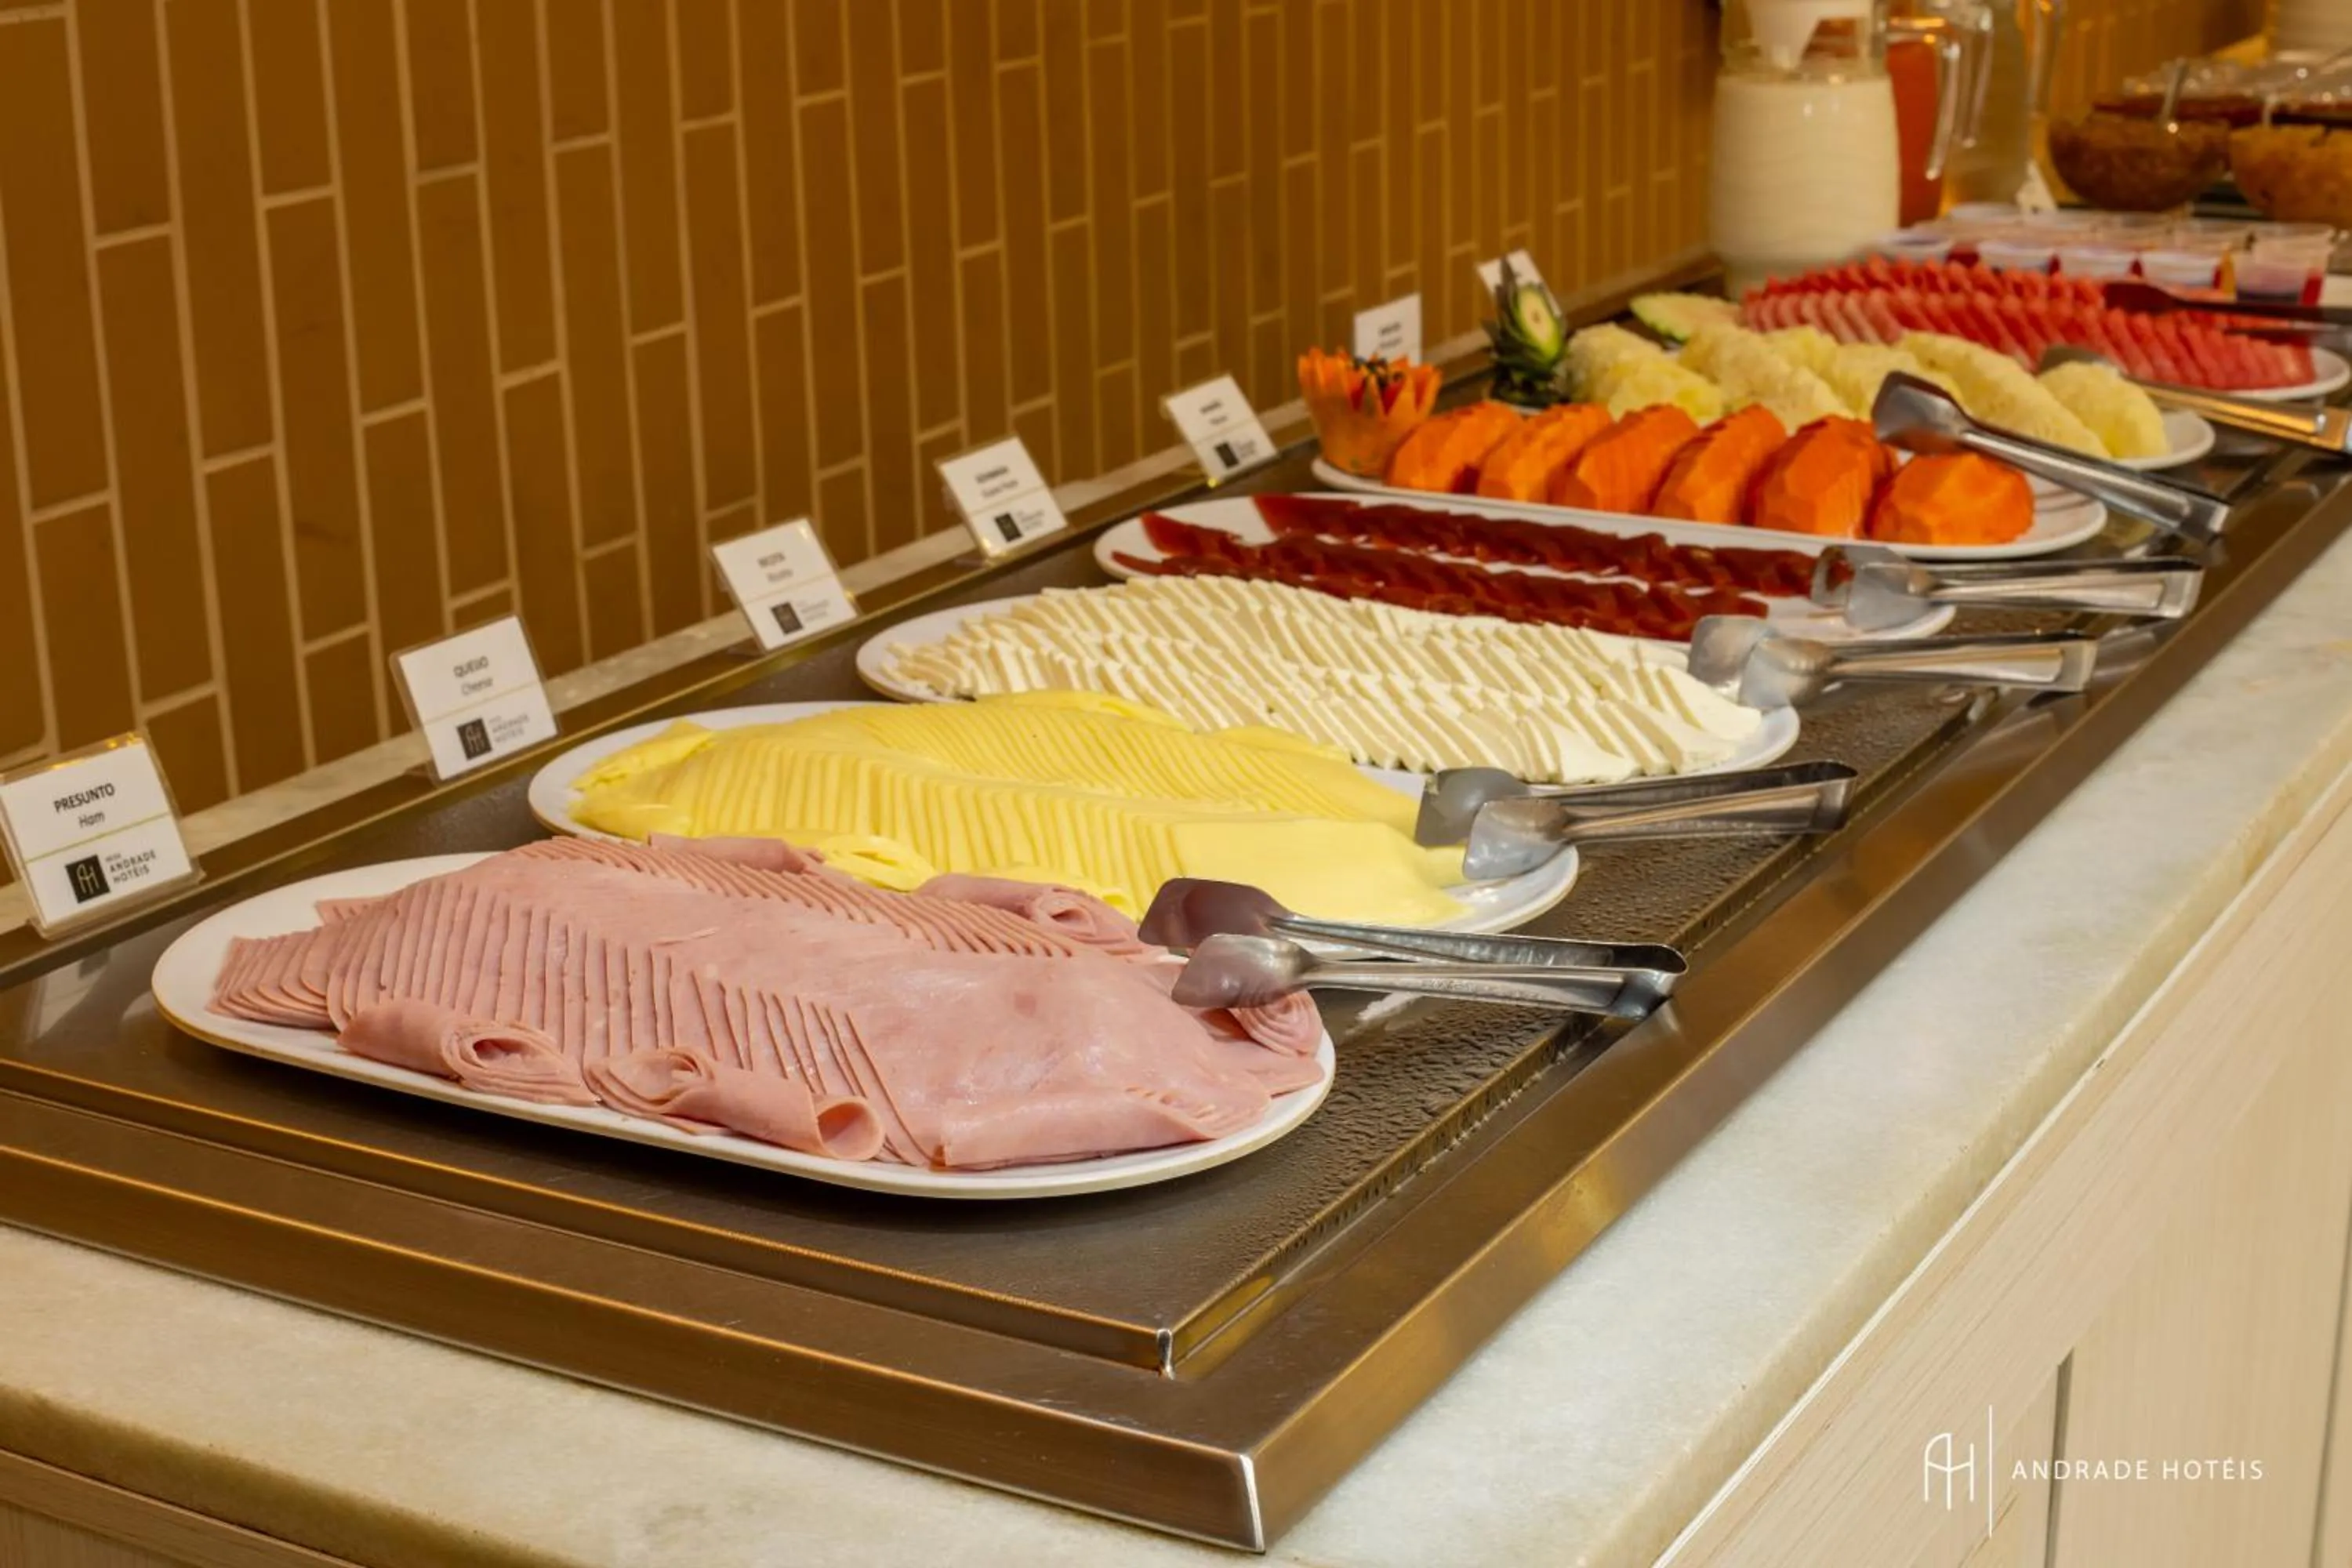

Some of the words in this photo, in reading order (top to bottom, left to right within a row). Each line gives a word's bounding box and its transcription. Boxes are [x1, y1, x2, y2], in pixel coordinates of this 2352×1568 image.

[53, 782, 115, 813] PRESUNTO
[78, 811, 106, 829] Ham
[110, 849, 156, 873] ANDRADE
